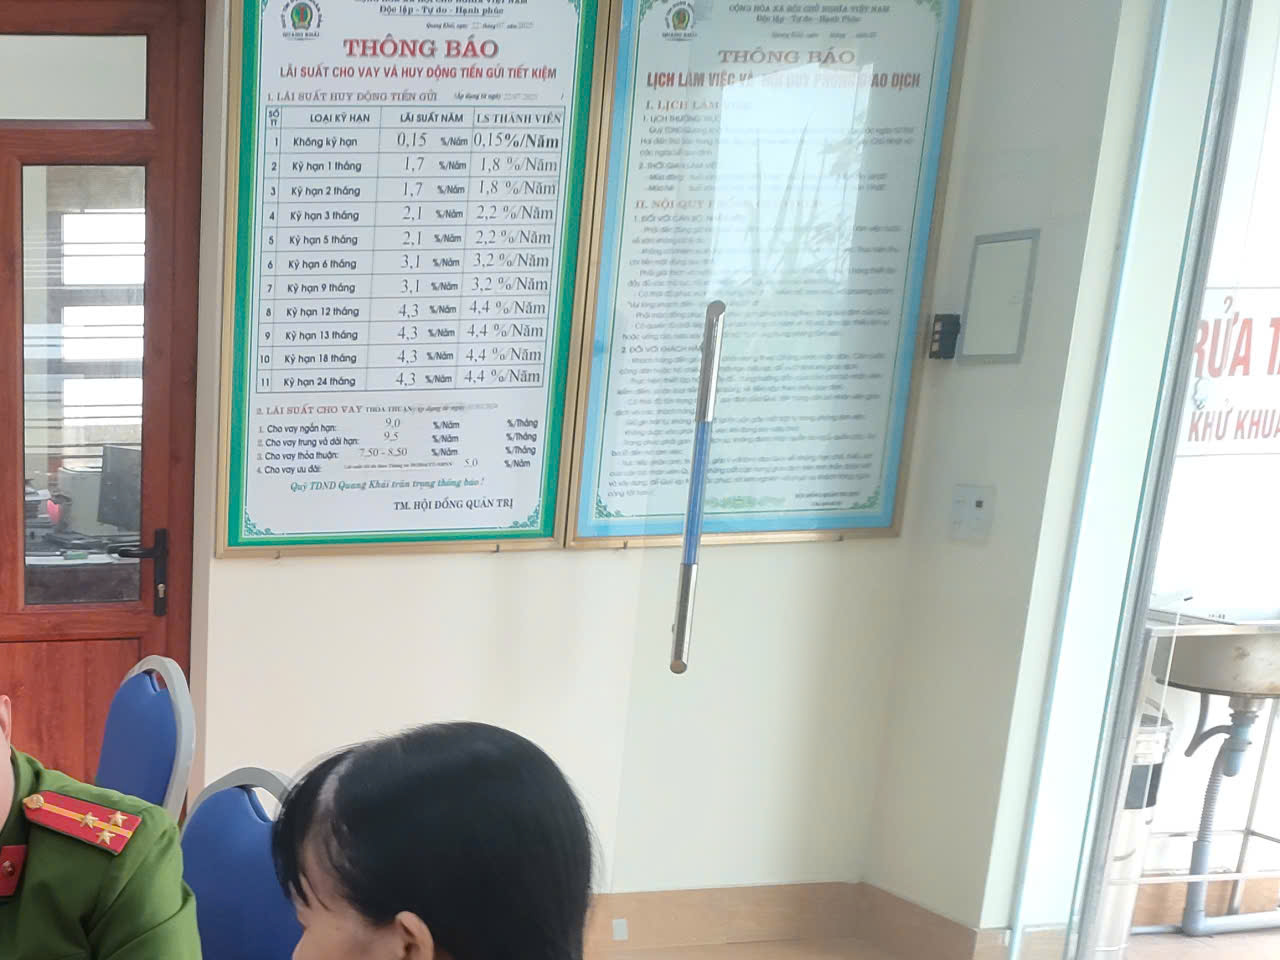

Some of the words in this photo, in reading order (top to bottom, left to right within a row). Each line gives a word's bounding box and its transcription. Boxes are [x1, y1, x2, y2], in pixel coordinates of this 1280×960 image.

[343, 33, 437, 58] THÔNG
[445, 34, 499, 58] BÁO
[718, 46, 800, 64] THÔNG
[808, 46, 856, 64] BÁO
[280, 64, 297, 78] LÃI
[300, 62, 329, 78] SUẤT
[332, 66, 355, 78] CHO
[358, 66, 380, 78] VAY
[384, 64, 398, 78] VÀ
[401, 66, 423, 78] HUY
[427, 65, 457, 81] ĐỘNG
[461, 63, 483, 79] TIỀN
[486, 63, 504, 79] GỬI
[508, 64, 528, 79] TIẾT
[531, 65, 557, 81] KIỆM
[647, 71, 675, 90] LỊCH
[891, 72, 920, 92] DỊCH
[330, 92, 353, 102] HUY
[310, 114, 332, 124] LOẠI
[349, 114, 370, 124] HẠN
[400, 112, 414, 122] LÃI
[416, 111, 439, 122] SUẤT
[441, 112, 464, 122] NĂM
[293, 137, 323, 148] Không
[326, 137, 337, 148] kỳ
[339, 137, 358, 147] hạn
[397, 132, 427, 148] 0,15
[292, 162, 304, 173] Kỳ
[306, 162, 324, 172] hạn
[334, 161, 361, 172] tháng
[405, 156, 425, 172] 1,7
[481, 157, 500, 173] 1,8
[291, 186, 303, 197] Kỳ
[305, 186, 323, 197] hạn
[325, 186, 331, 195] 2
[333, 185, 360, 197] tháng
[403, 182, 423, 197] 1,7
[479, 179, 498, 195] 1,8
[290, 211, 302, 222] Kỳ
[304, 211, 322, 221] hạn
[324, 211, 330, 220] 3
[332, 210, 359, 222] tháng
[402, 205, 422, 220] 2,1
[476, 205, 497, 220] 2,2
[289, 235, 301, 246] Kỳ
[303, 235, 321, 246] hạn
[323, 235, 329, 244] 5
[331, 234, 358, 246] tháng
[402, 230, 421, 246] 2,1
[475, 230, 496, 245] 2,2
[288, 259, 300, 270] Kỳ
[302, 260, 320, 270] hạn
[322, 259, 328, 268] 6
[330, 258, 357, 270] tháng
[400, 254, 420, 269] 3,1
[473, 252, 494, 268] 3,2
[287, 283, 299, 294] Kỳ
[301, 283, 319, 293] hạn
[321, 283, 327, 292] 9
[329, 282, 355, 294] tháng
[400, 279, 419, 294] 3,1
[471, 276, 492, 292] 3,2
[286, 307, 298, 318] Kỳ
[300, 307, 318, 318] hạn
[320, 307, 331, 316] 12
[333, 306, 360, 317] tháng
[399, 303, 419, 318] 4,3
[469, 300, 490, 315] 4,4
[285, 331, 297, 342] Kỳ
[299, 331, 317, 341] hạn
[320, 331, 330, 339] 13
[331, 330, 358, 341] tháng
[397, 326, 418, 340] 4,3
[467, 323, 488, 338] 4,4
[260, 355, 270, 364] 10
[284, 354, 296, 365] Kỳ
[298, 354, 315, 364] hạn
[319, 354, 329, 363] 18
[331, 353, 357, 364] tháng
[397, 349, 418, 364] 4,3
[466, 348, 486, 363] 4,4
[261, 378, 270, 387] 11
[284, 377, 295, 388] Kỳ
[297, 377, 315, 387] hạn
[317, 377, 327, 386] 24
[329, 376, 356, 387] tháng
[395, 372, 416, 387] 4,3
[464, 369, 485, 384] 4,4
[317, 406, 338, 414] CHO
[340, 405, 362, 414] VAY
[267, 424, 282, 433] Cho
[265, 439, 281, 447] Cho
[265, 452, 280, 460] Cho
[265, 465, 280, 474] Cho
[394, 501, 410, 510] TM.
[413, 498, 432, 511] HỘI
[435, 496, 463, 510] ĐỒNG
[466, 496, 494, 510] QUẢN
[497, 498, 513, 510] TRỊ
